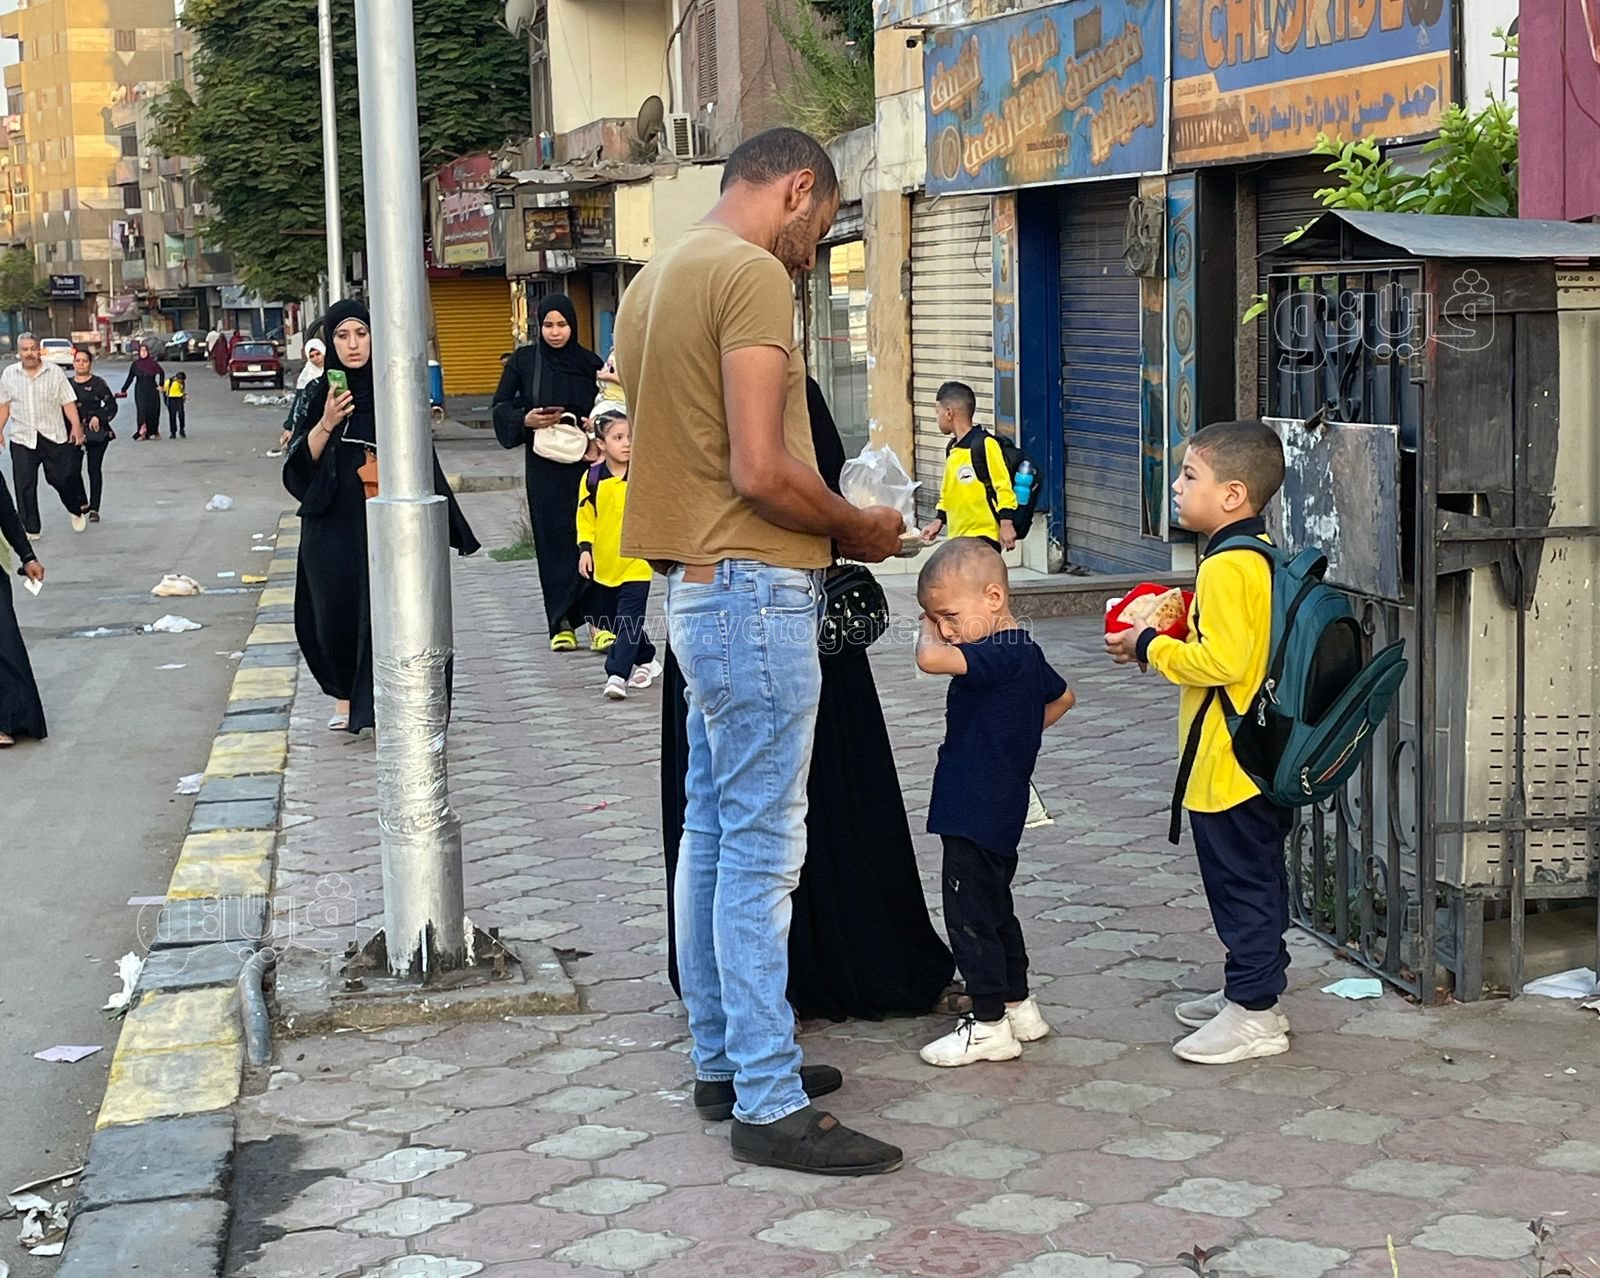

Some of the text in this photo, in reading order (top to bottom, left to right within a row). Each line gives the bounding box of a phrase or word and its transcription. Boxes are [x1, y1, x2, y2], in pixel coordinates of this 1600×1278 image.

[963, 20, 1143, 177] محسن الزقازيقي
[1009, 15, 1059, 88] مركز
